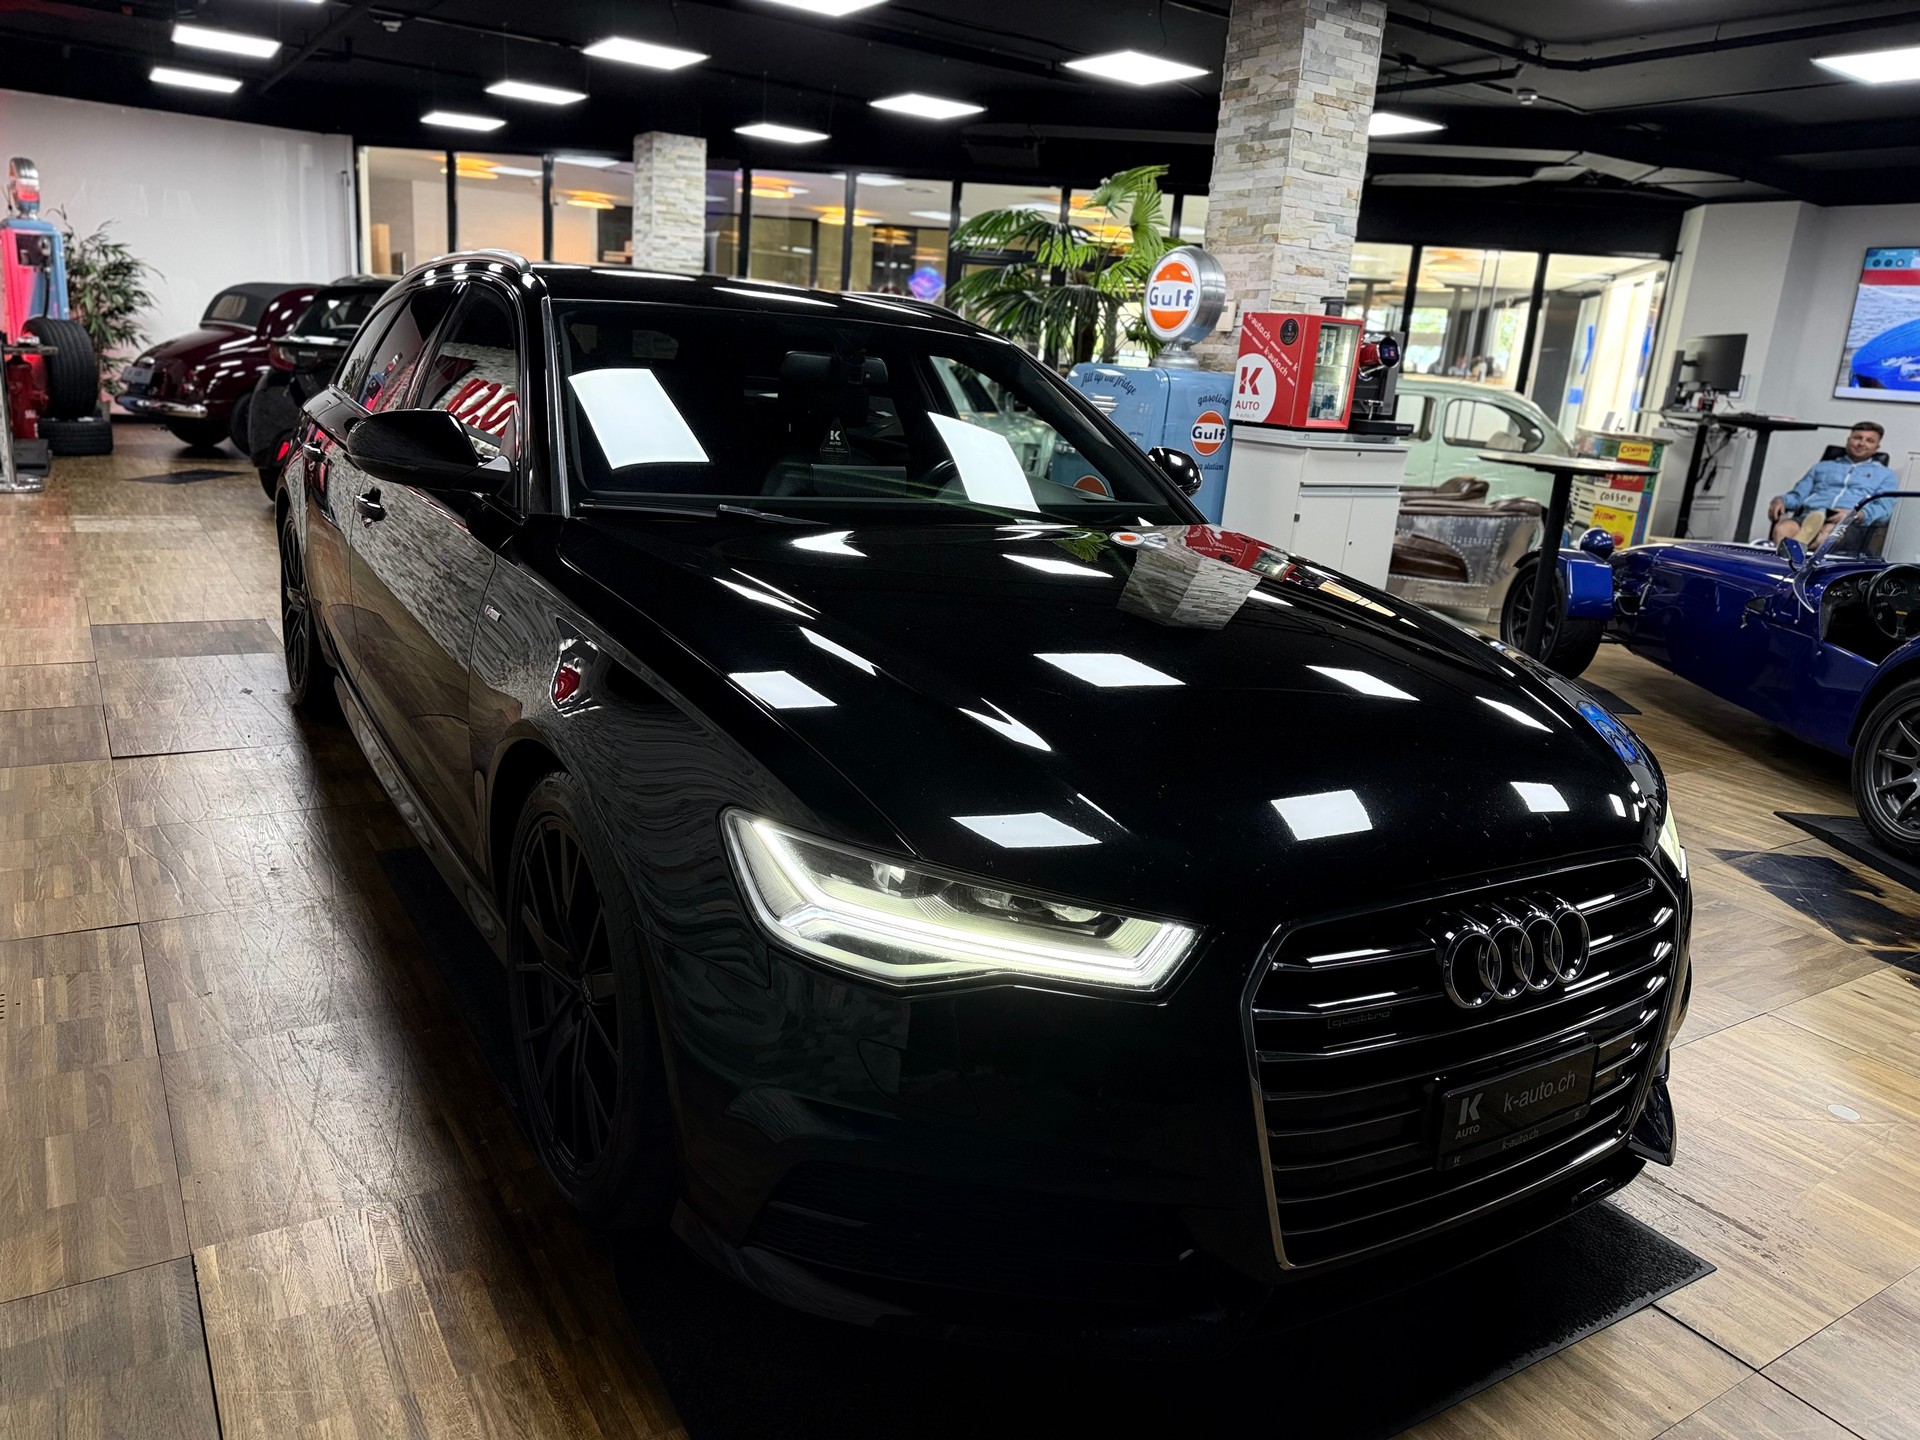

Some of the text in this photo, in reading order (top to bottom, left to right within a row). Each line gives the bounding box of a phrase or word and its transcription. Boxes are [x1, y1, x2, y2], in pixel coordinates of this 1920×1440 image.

[1149, 286, 1194, 307] Gulf
[1247, 312, 1271, 341] k-auto.ch
[1263, 346, 1288, 377] k-auto.ch
[1113, 376, 1137, 396] fridge
[1238, 366, 1263, 396] K
[1197, 393, 1230, 407] gasoline
[1235, 400, 1260, 411] AUTO
[830, 430, 841, 441] K
[1192, 425, 1226, 441] Gulf
[1503, 1070, 1576, 1113] k-auto.ch
[1458, 1092, 1484, 1126] K
[1455, 1124, 1480, 1140] AUTO
